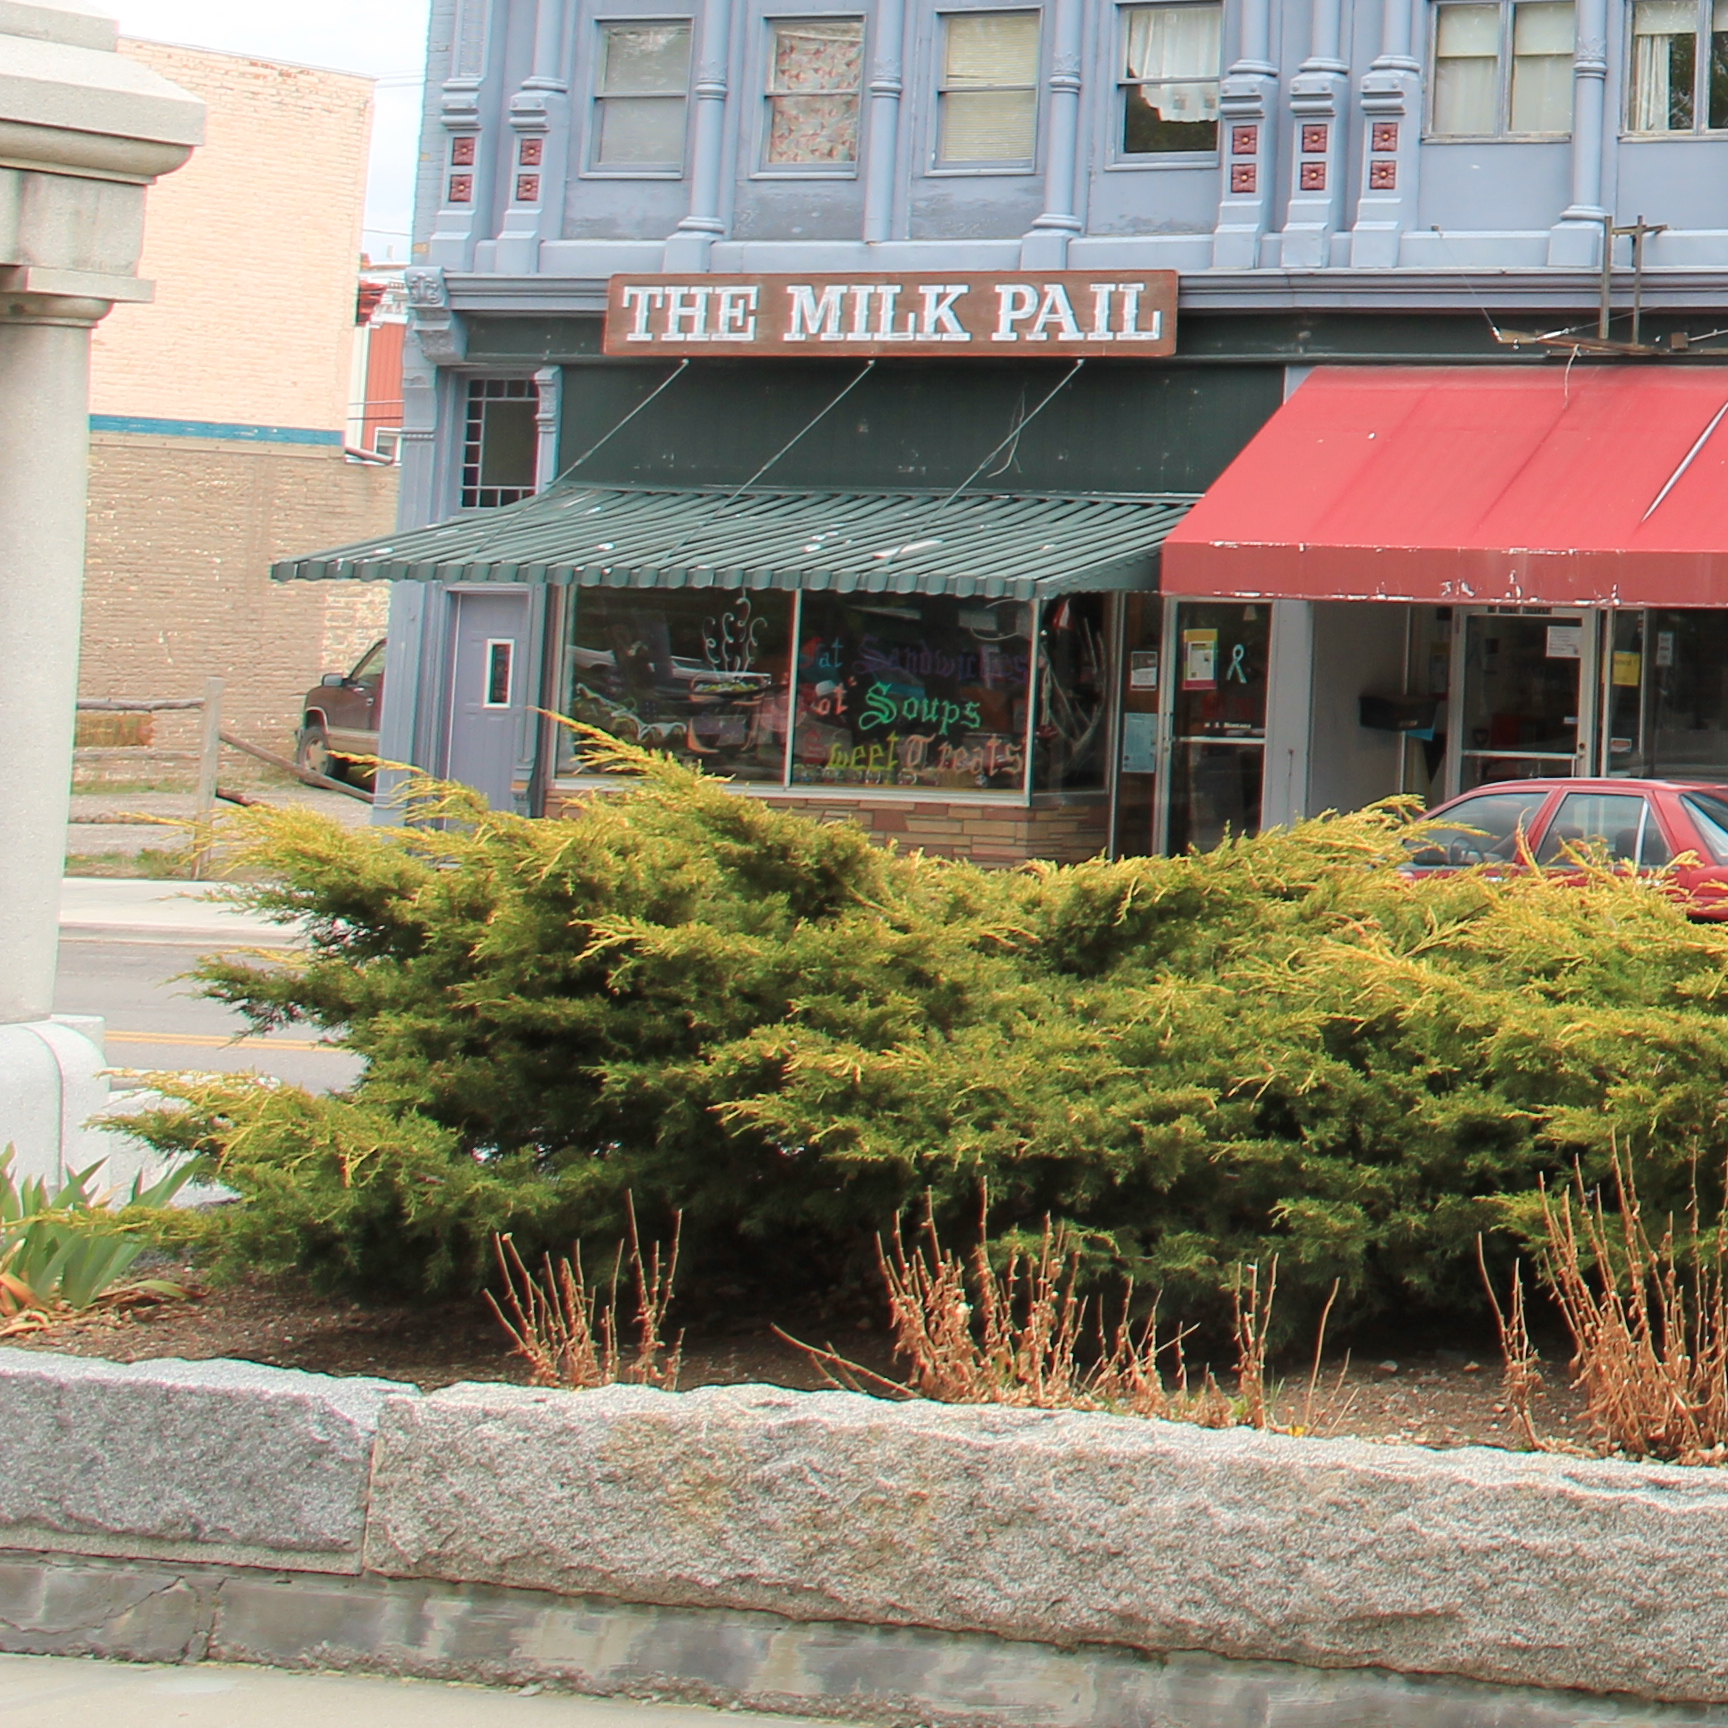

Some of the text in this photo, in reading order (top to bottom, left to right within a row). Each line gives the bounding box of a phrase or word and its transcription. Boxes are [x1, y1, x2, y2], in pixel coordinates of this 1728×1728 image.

[622, 282, 1162, 342] THE MILK PAIL
[858, 680, 981, 736] Soups
[901, 732, 1024, 777] Treats
